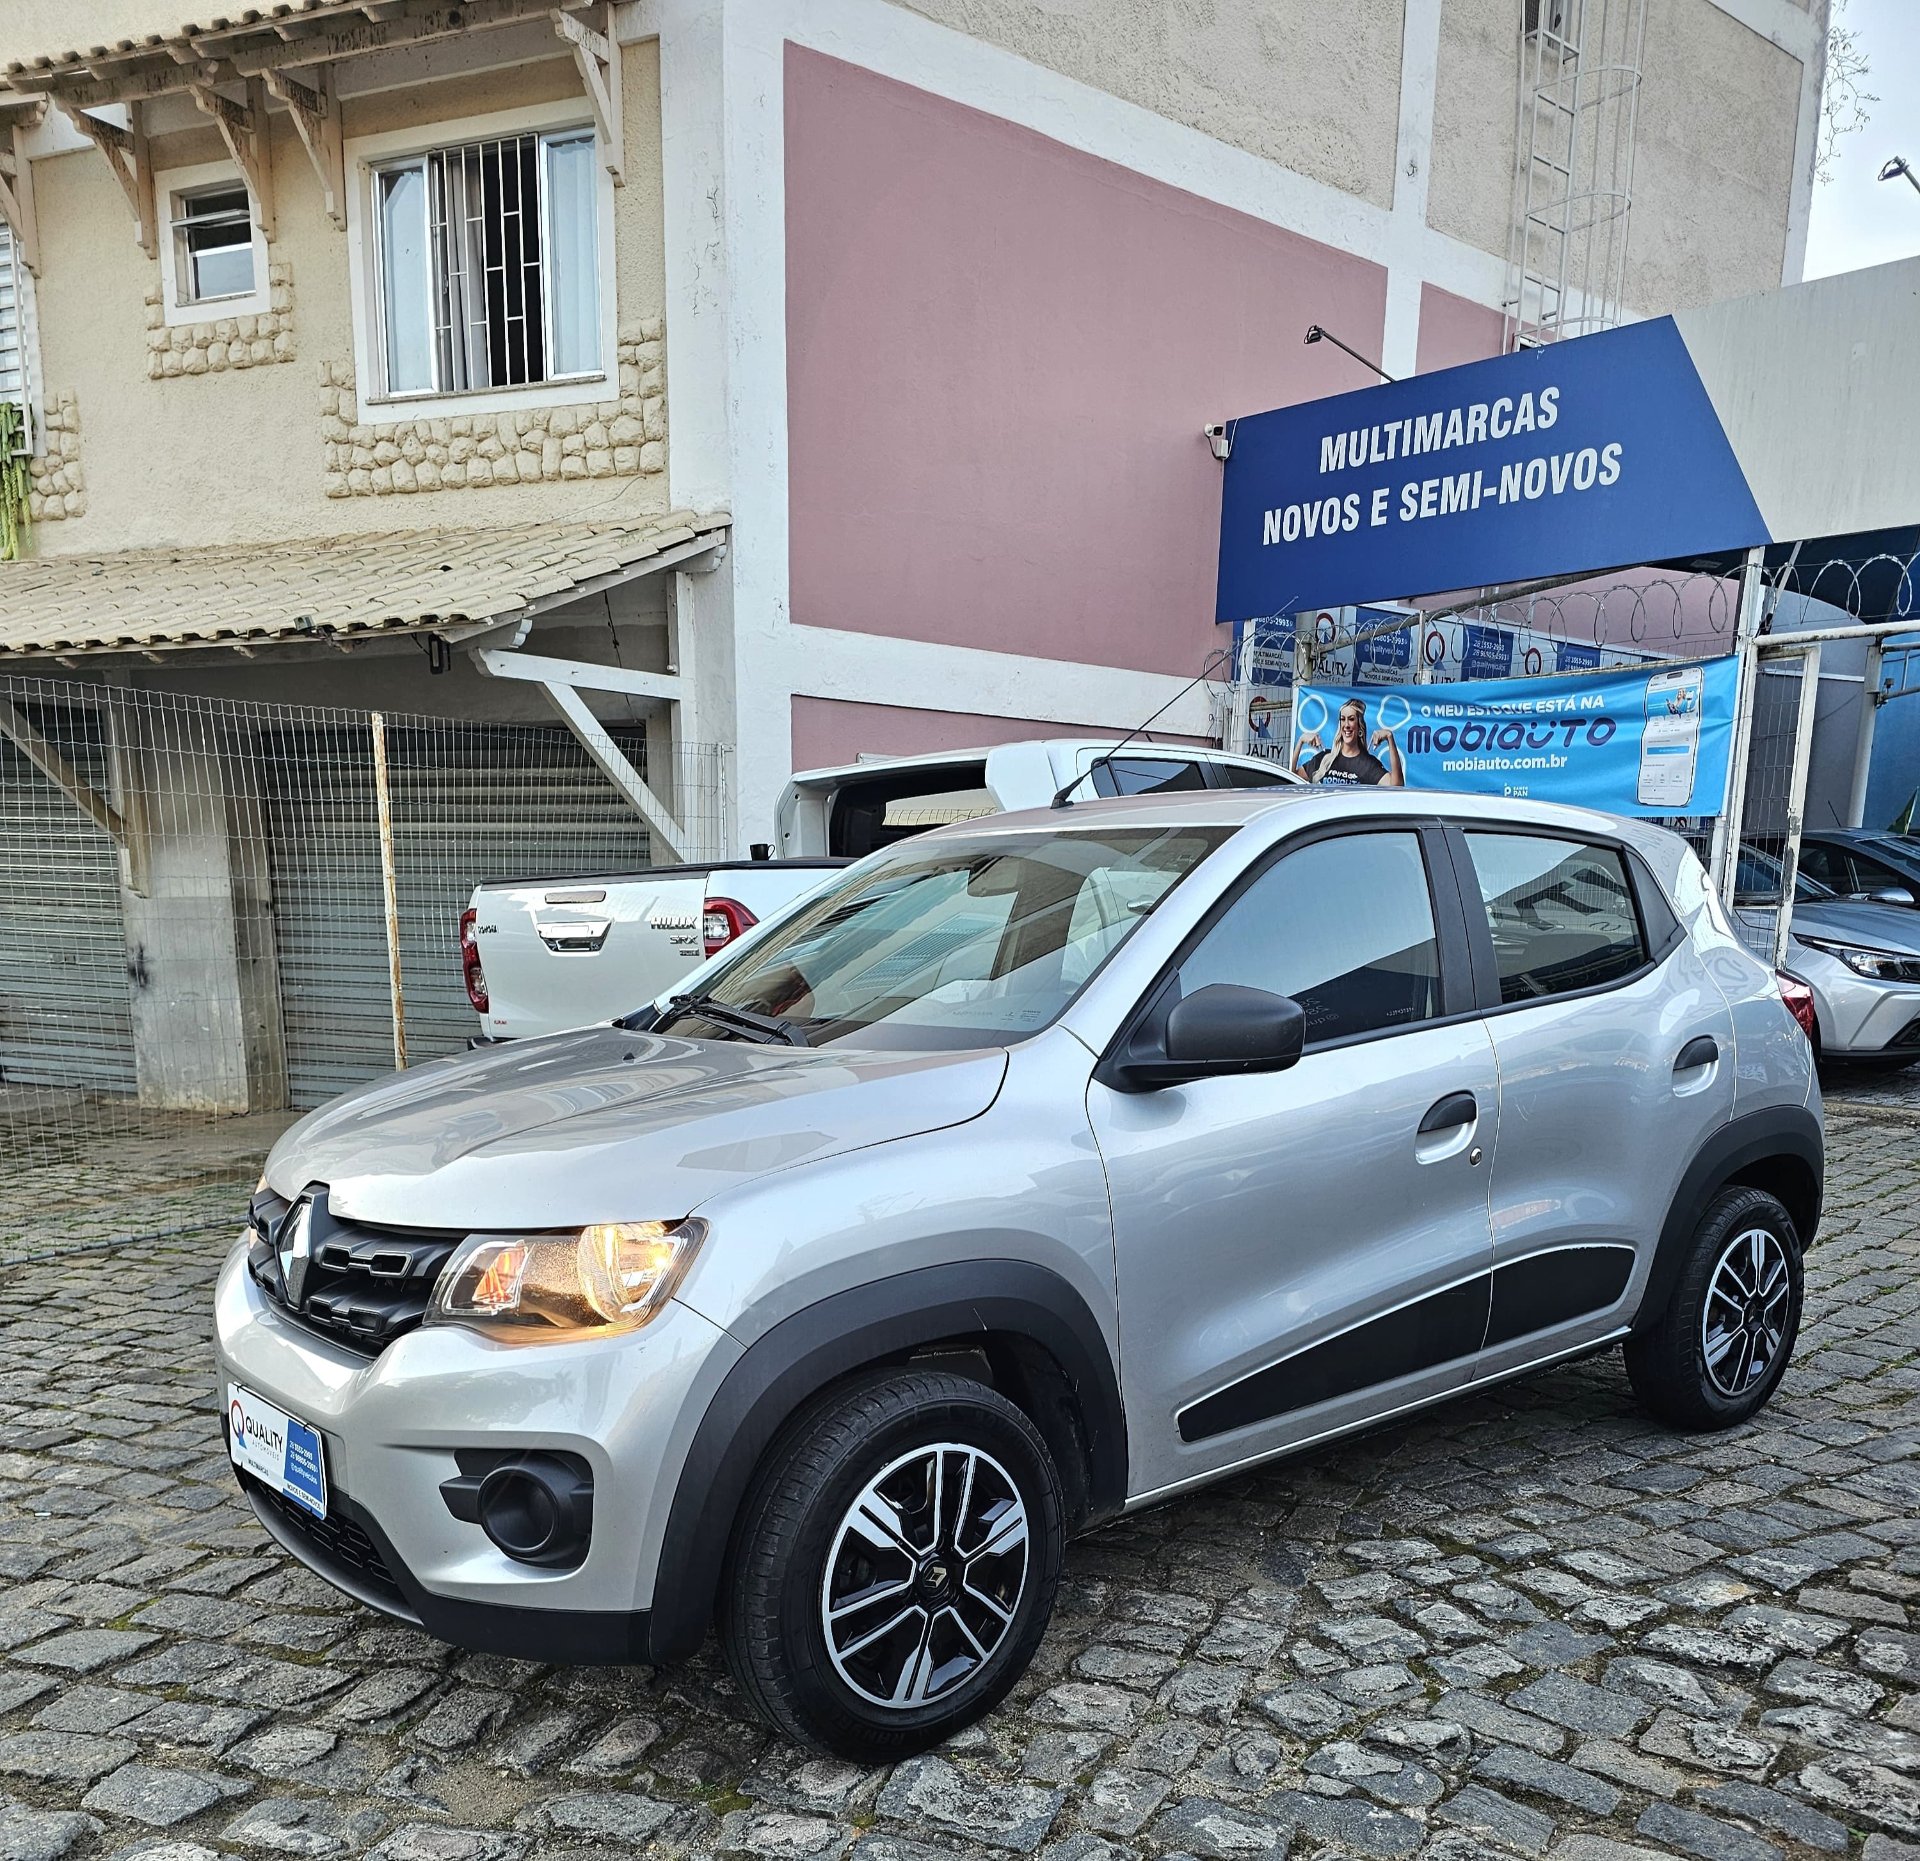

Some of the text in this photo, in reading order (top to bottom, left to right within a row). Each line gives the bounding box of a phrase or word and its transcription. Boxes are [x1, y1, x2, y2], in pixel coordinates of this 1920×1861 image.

[1319, 386, 1560, 474] MULTIMARCAS
[1262, 442, 1624, 546] NOVOS E SEMI-NOVOS
[1311, 658, 1348, 676] UALITY
[1420, 694, 1605, 718] O MEU ESTOQUE ESTÁ NA
[1246, 743, 1283, 759] ALITY
[1442, 754, 1568, 772] mobiauto.com.br
[669, 935, 698, 944] SRX
[245, 1416, 283, 1453] QUALITY
